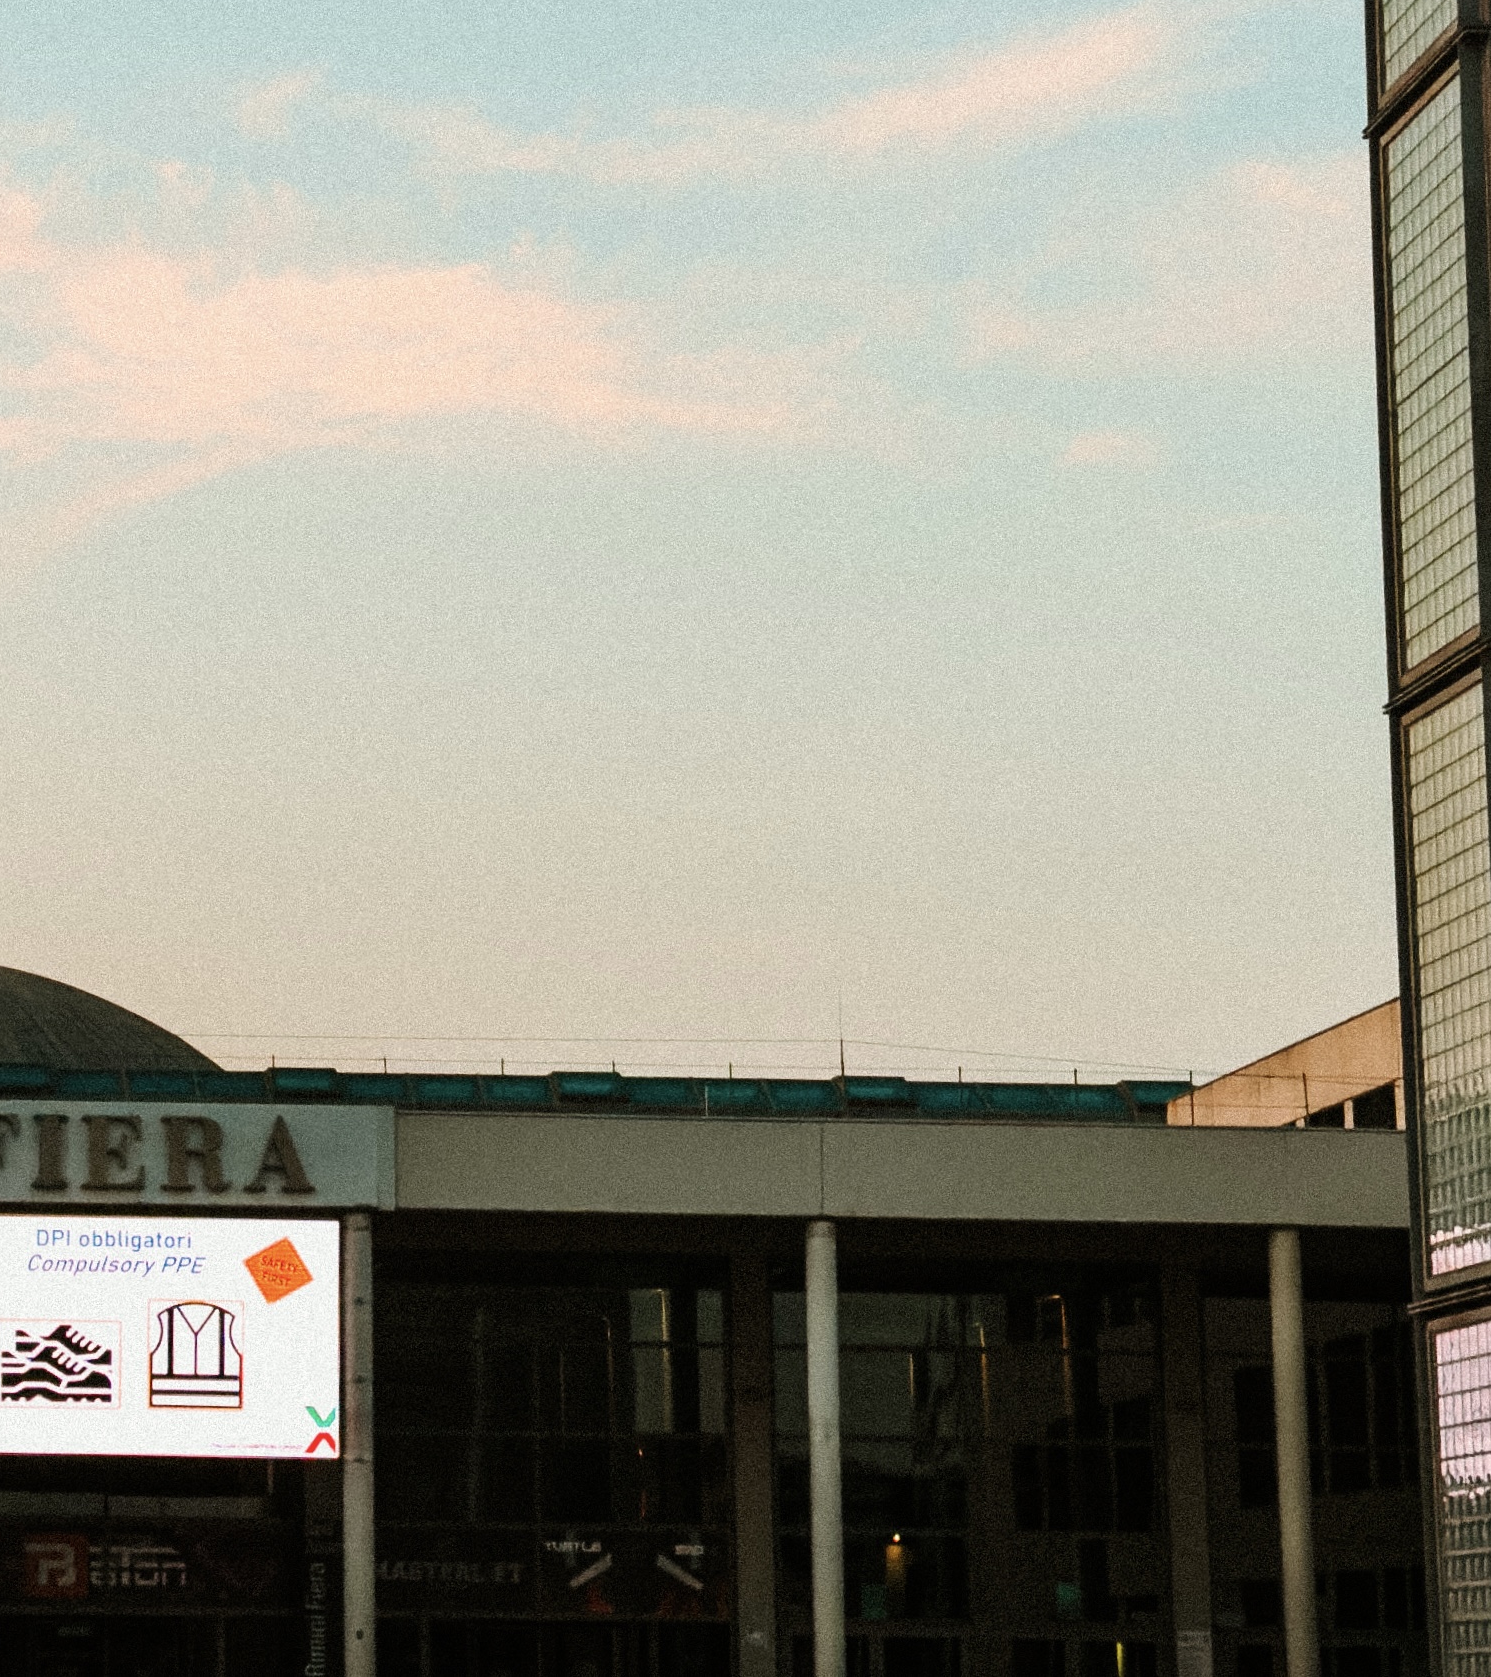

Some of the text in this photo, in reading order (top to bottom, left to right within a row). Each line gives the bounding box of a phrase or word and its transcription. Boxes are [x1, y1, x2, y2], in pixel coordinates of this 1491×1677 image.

[36, 1229, 192, 1252] DPI obbligatori
[27, 1254, 207, 1277] Compulsory PPE
[261, 1255, 299, 1273] SAFETY
[262, 1271, 292, 1287] FIRST
[304, 1562, 327, 1611] Fiera
